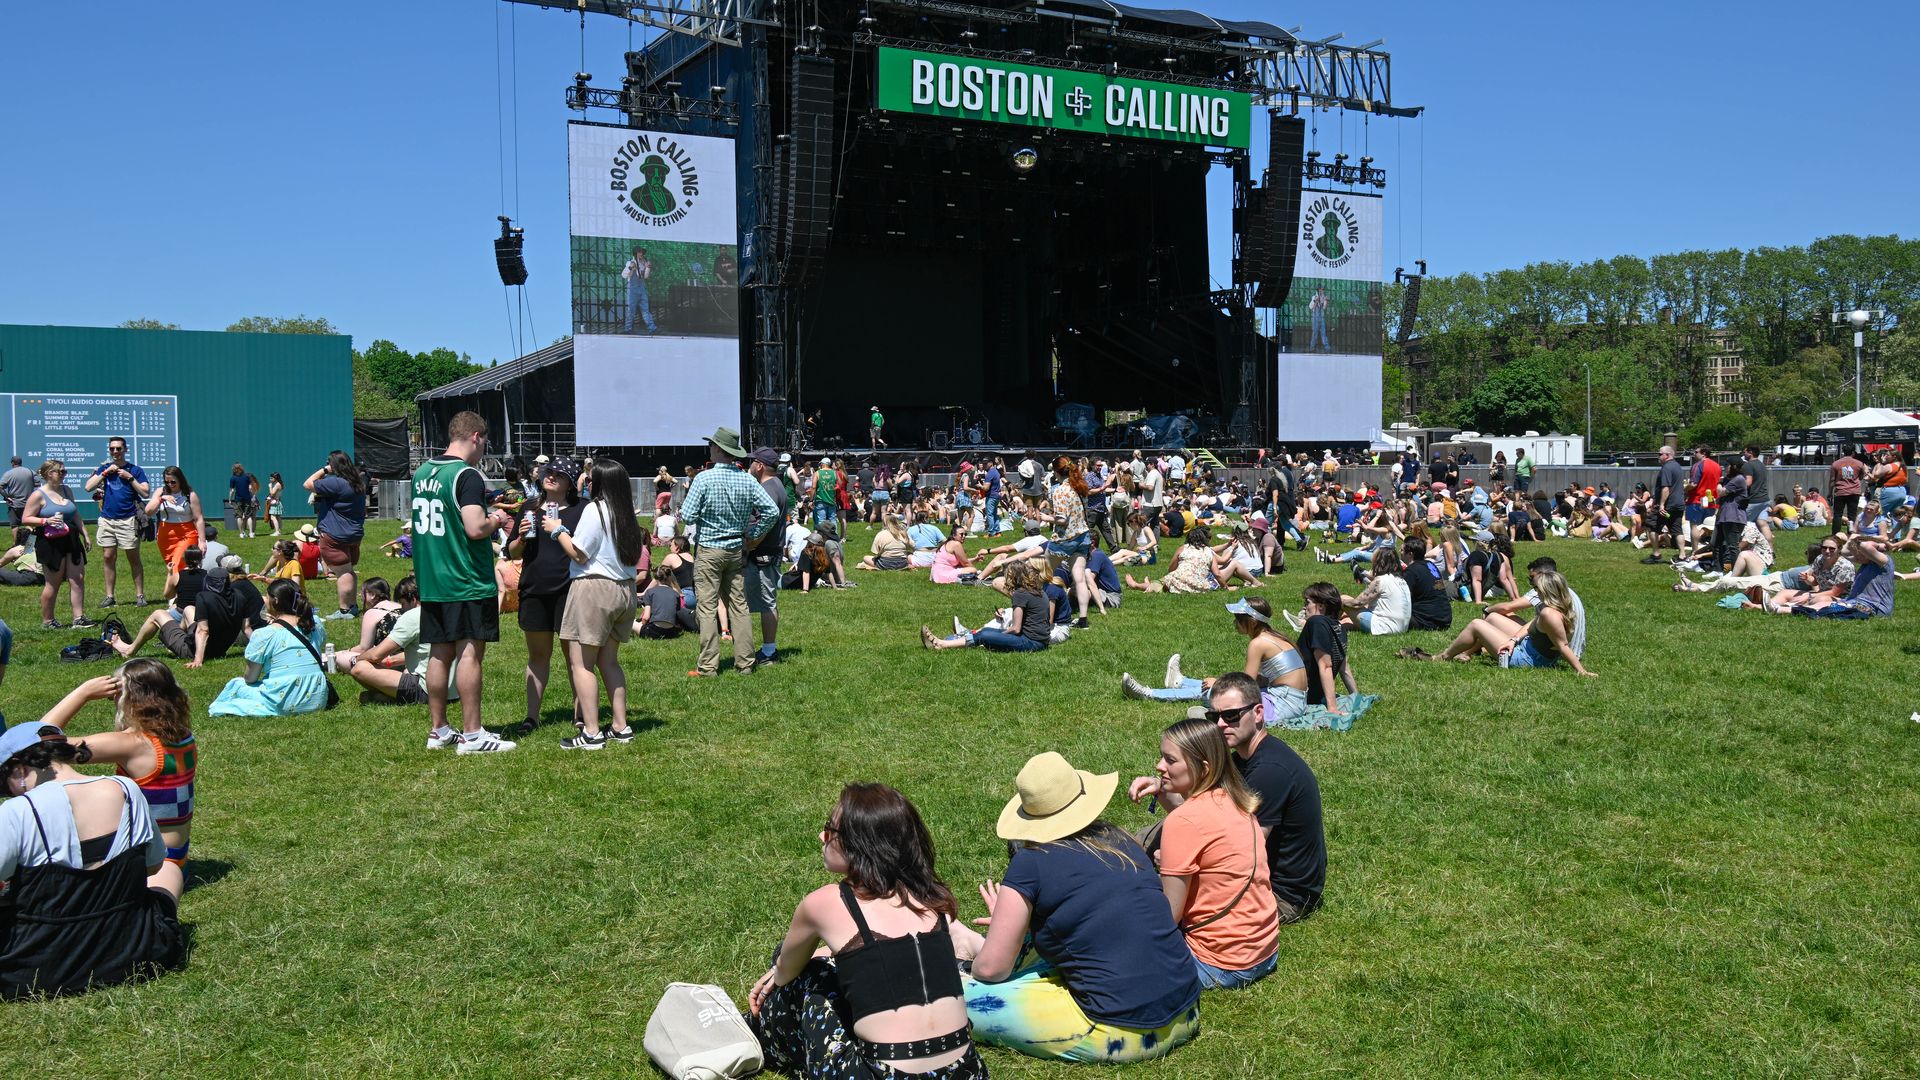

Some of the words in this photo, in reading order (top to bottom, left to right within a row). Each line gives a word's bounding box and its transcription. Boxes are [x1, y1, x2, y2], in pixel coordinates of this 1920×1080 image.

[912, 59, 1053, 118] BOSTON
[1106, 84, 1229, 137] CALLING
[610, 134, 652, 191] BOSTON
[656, 136, 699, 196] CALLING
[623, 203, 650, 226] MUSIC
[653, 207, 687, 227] FESTIVAL
[1303, 195, 1329, 241] BOSTON
[1333, 197, 1358, 244] CALLING
[1311, 250, 1327, 268] MUSIC
[1329, 253, 1351, 269] FESTIVAL
[415, 478, 442, 495] SMART
[412, 497, 446, 537] 36
